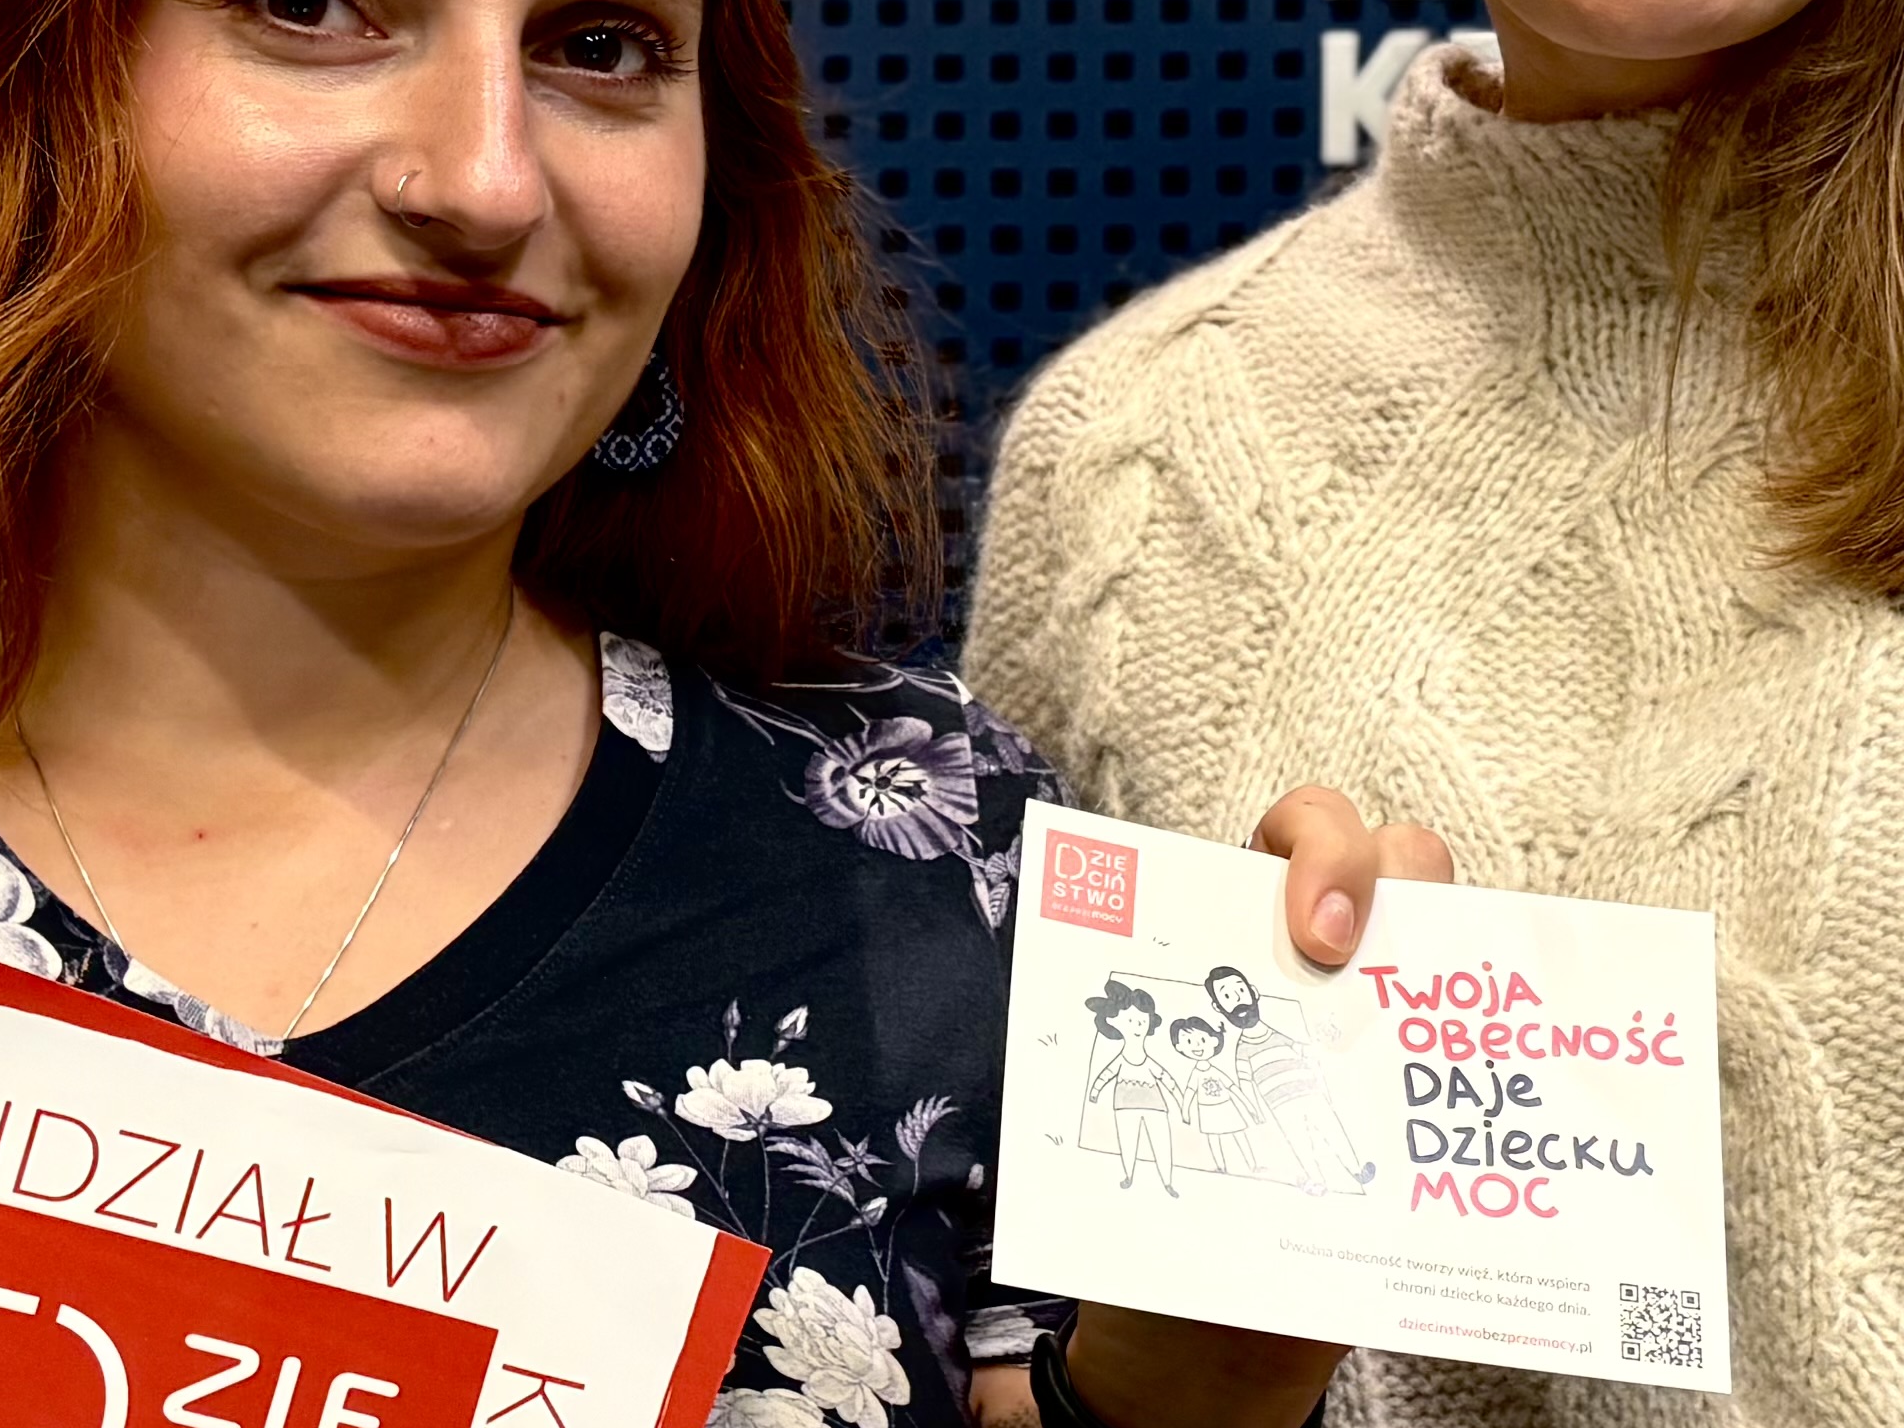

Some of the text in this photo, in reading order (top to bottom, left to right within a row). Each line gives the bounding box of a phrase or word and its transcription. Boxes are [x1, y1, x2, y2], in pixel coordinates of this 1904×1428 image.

[1052, 881, 1125, 911] STWO
[1410, 1171, 1559, 1219] MOC
[384, 1197, 498, 1303] W
[1338, 1248, 1403, 1269] obecność
[1407, 1259, 1454, 1277] tworzy
[1497, 1269, 1533, 1285] która
[1537, 1277, 1591, 1292] wspiera
[1392, 1280, 1436, 1296] chroni
[1440, 1286, 1493, 1304] dziecko
[1497, 1293, 1554, 1313] każdego
[1558, 1301, 1592, 1317] dnia.
[1398, 1316, 1594, 1355] dziecinstwobezprzemocy.pl
